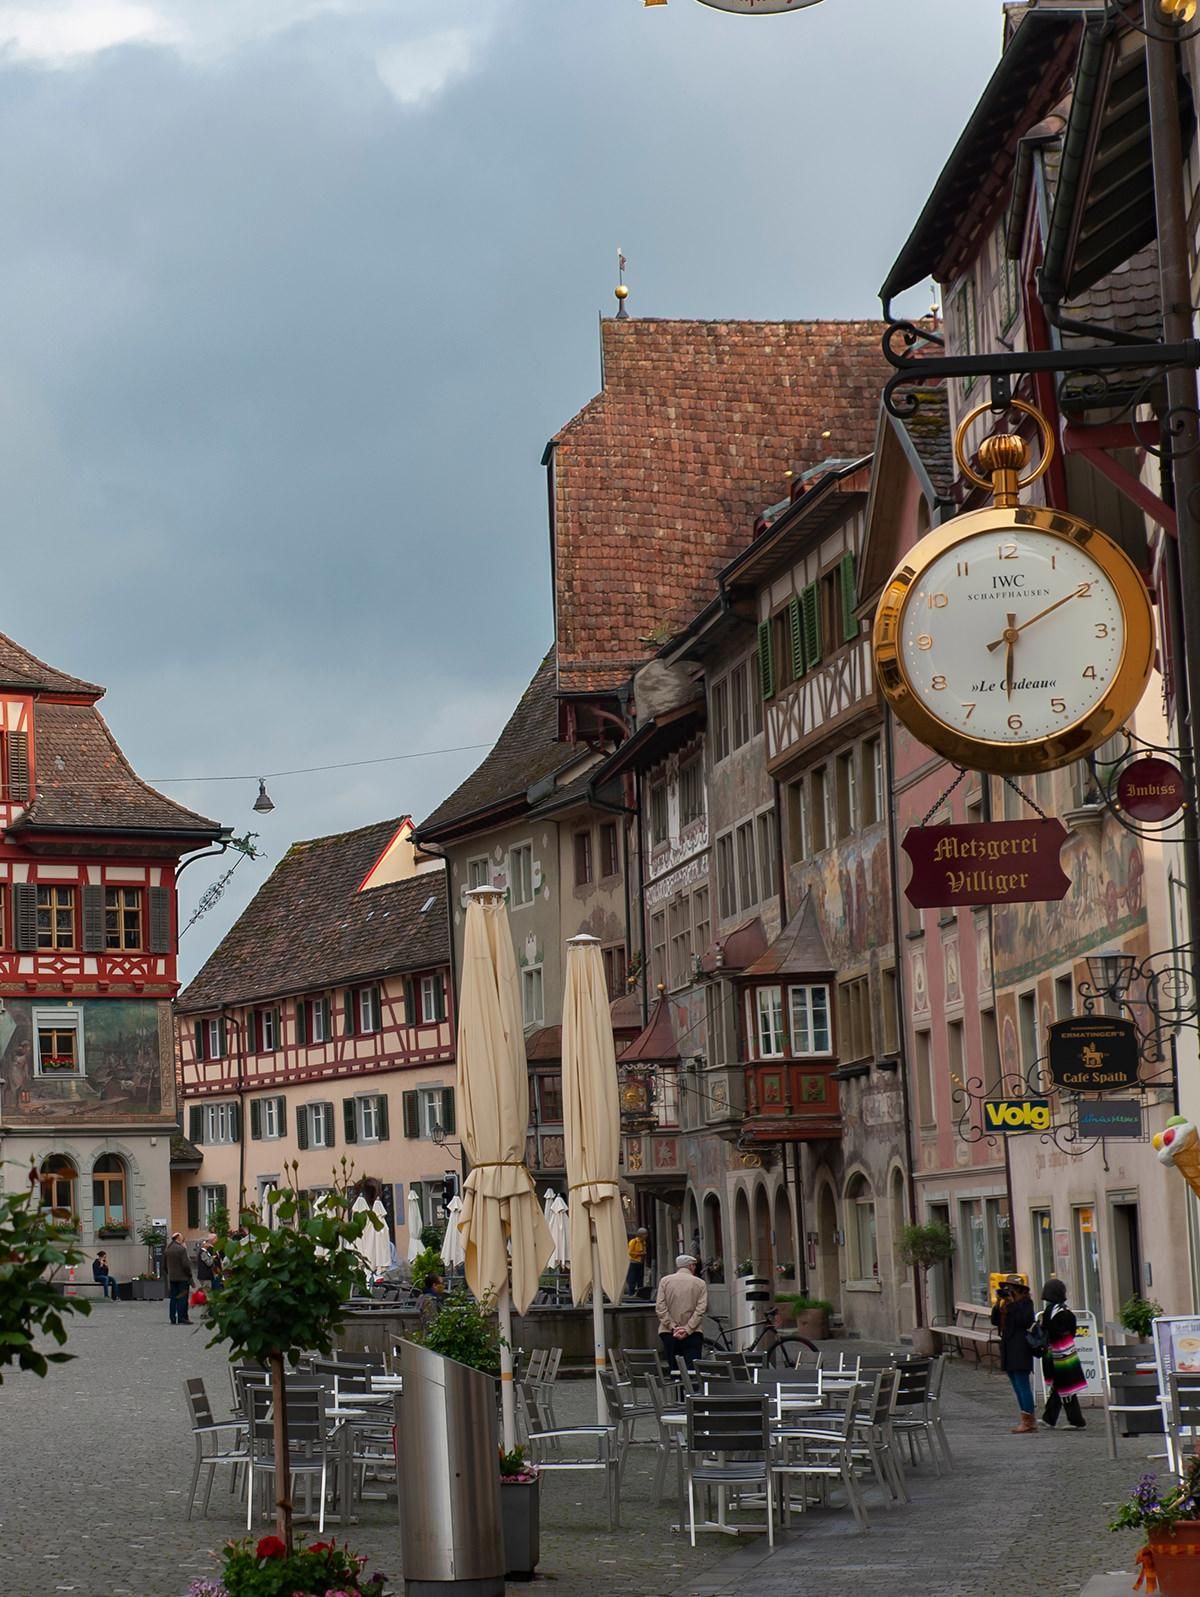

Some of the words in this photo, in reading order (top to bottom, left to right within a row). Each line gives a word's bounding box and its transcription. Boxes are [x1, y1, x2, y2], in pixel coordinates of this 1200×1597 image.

[998, 543, 1019, 560] 12
[956, 560, 969, 577] 11
[1050, 555, 1056, 570] 1
[992, 574, 1025, 589] IWC
[967, 589, 1050, 601] SCHAFFHAUSEN
[1077, 582, 1092, 598] 2
[928, 592, 949, 609] 10
[1094, 623, 1109, 639] 3
[916, 634, 932, 651] 9
[1081, 665, 1097, 681] 4
[931, 674, 947, 691] 8
[961, 704, 976, 720] 7
[1051, 698, 1066, 714] 5
[1007, 714, 1023, 730] 6
[1127, 783, 1176, 797] Imbiss
[933, 832, 1038, 862] Metzgerei
[946, 872, 1029, 894] Villiger
[987, 1103, 1050, 1130] Volg
